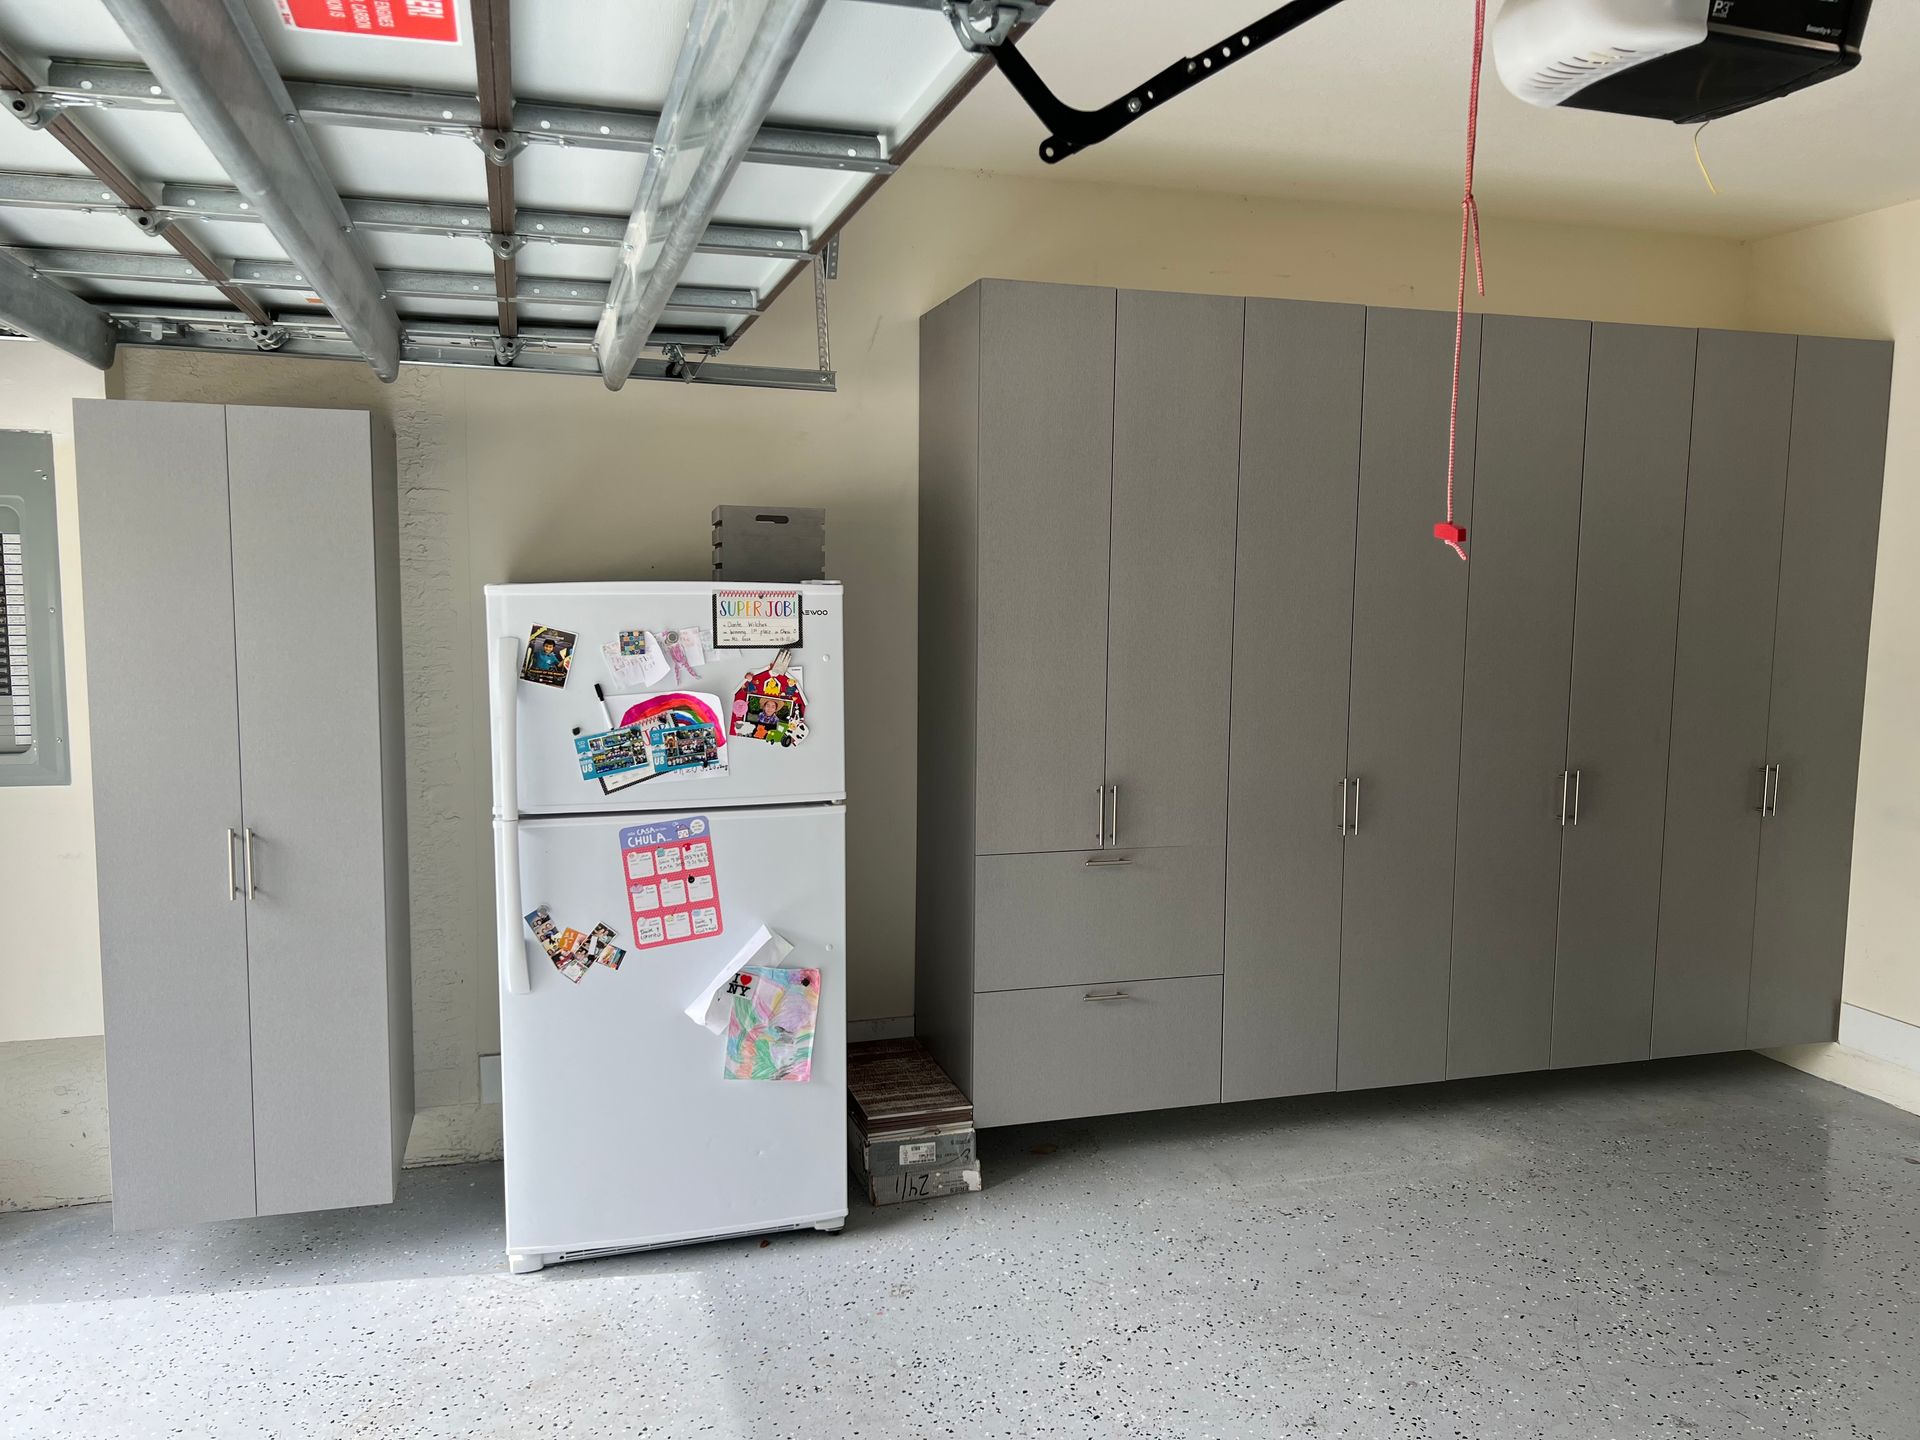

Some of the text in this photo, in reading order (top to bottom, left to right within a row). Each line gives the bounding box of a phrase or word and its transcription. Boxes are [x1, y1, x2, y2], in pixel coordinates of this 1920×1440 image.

[719, 600, 796, 617] SUPER JOB!
[654, 756, 665, 766] U8
[582, 763, 593, 773] U8
[636, 827, 656, 835] CASA
[627, 832, 666, 847] CHULA
[732, 972, 741, 984] I
[726, 982, 751, 997] NY
